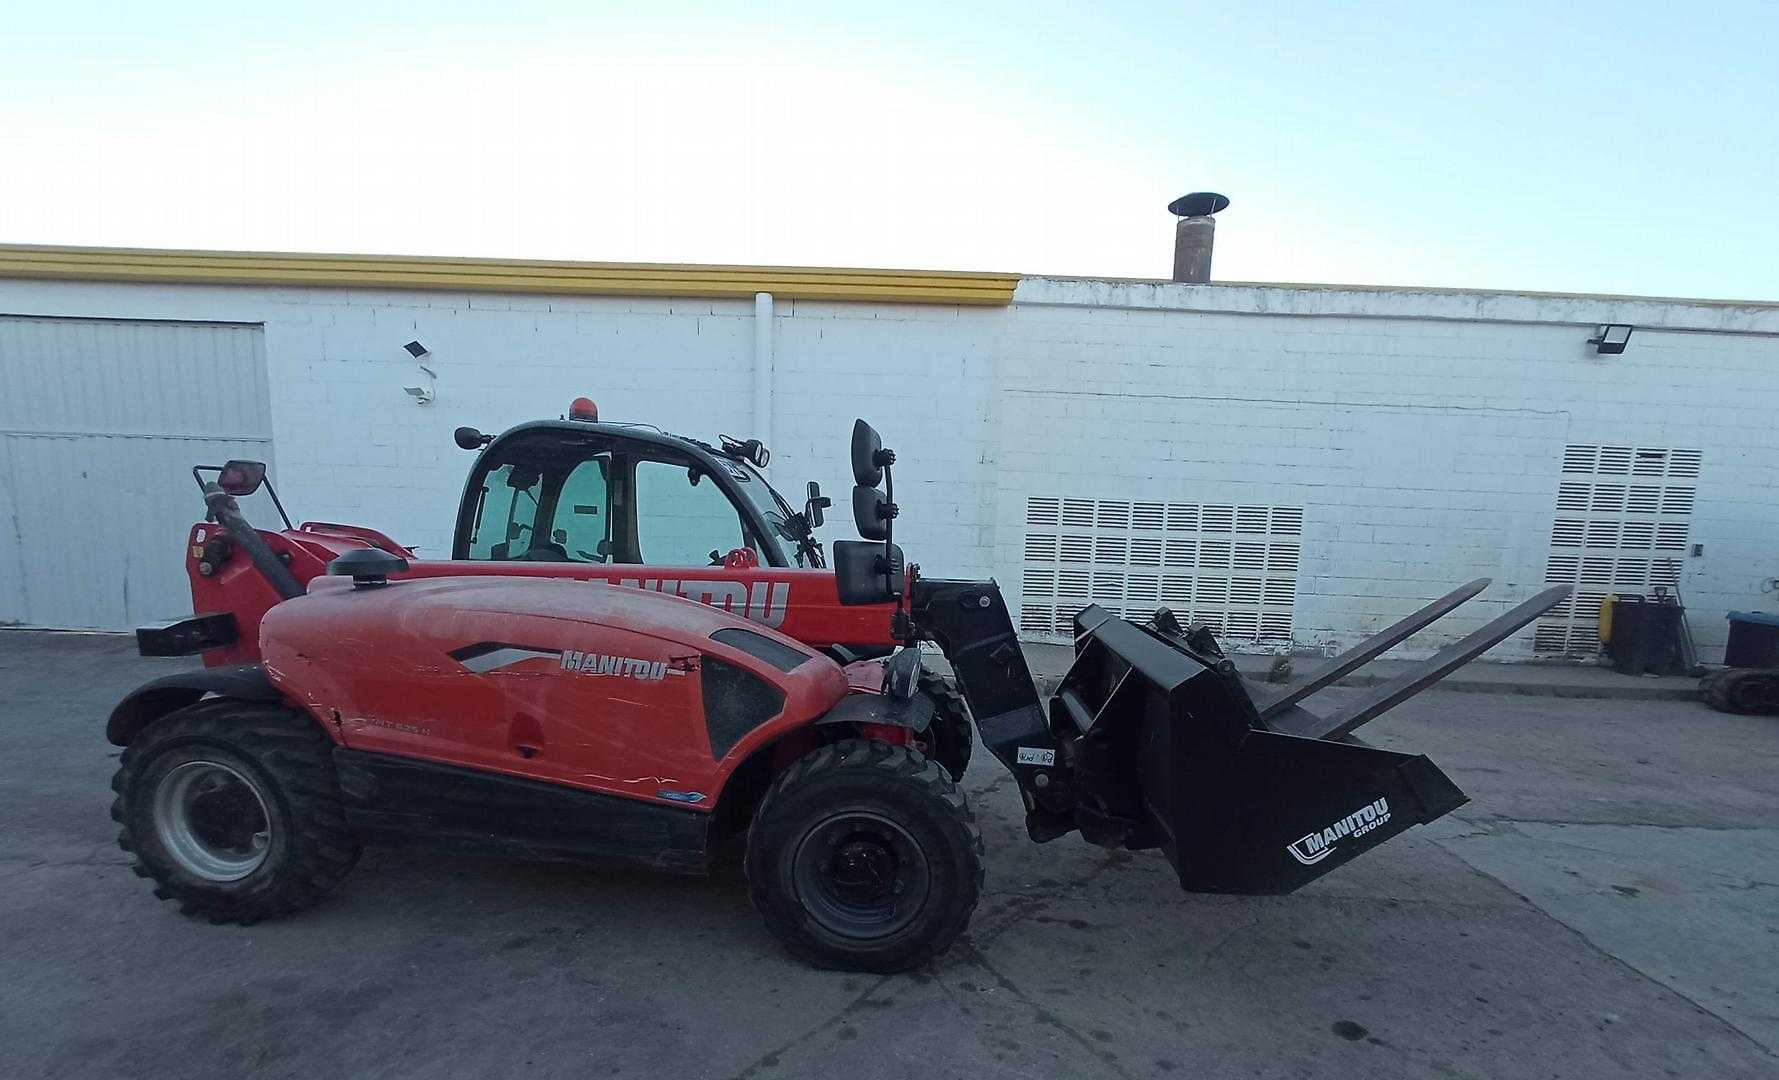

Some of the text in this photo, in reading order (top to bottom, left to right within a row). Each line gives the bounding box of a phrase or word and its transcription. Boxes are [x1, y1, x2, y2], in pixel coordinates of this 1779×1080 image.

[560, 650, 667, 680] MANITOU
[1305, 797, 1389, 854] MANITOU
[1353, 813, 1391, 838] GROUP
